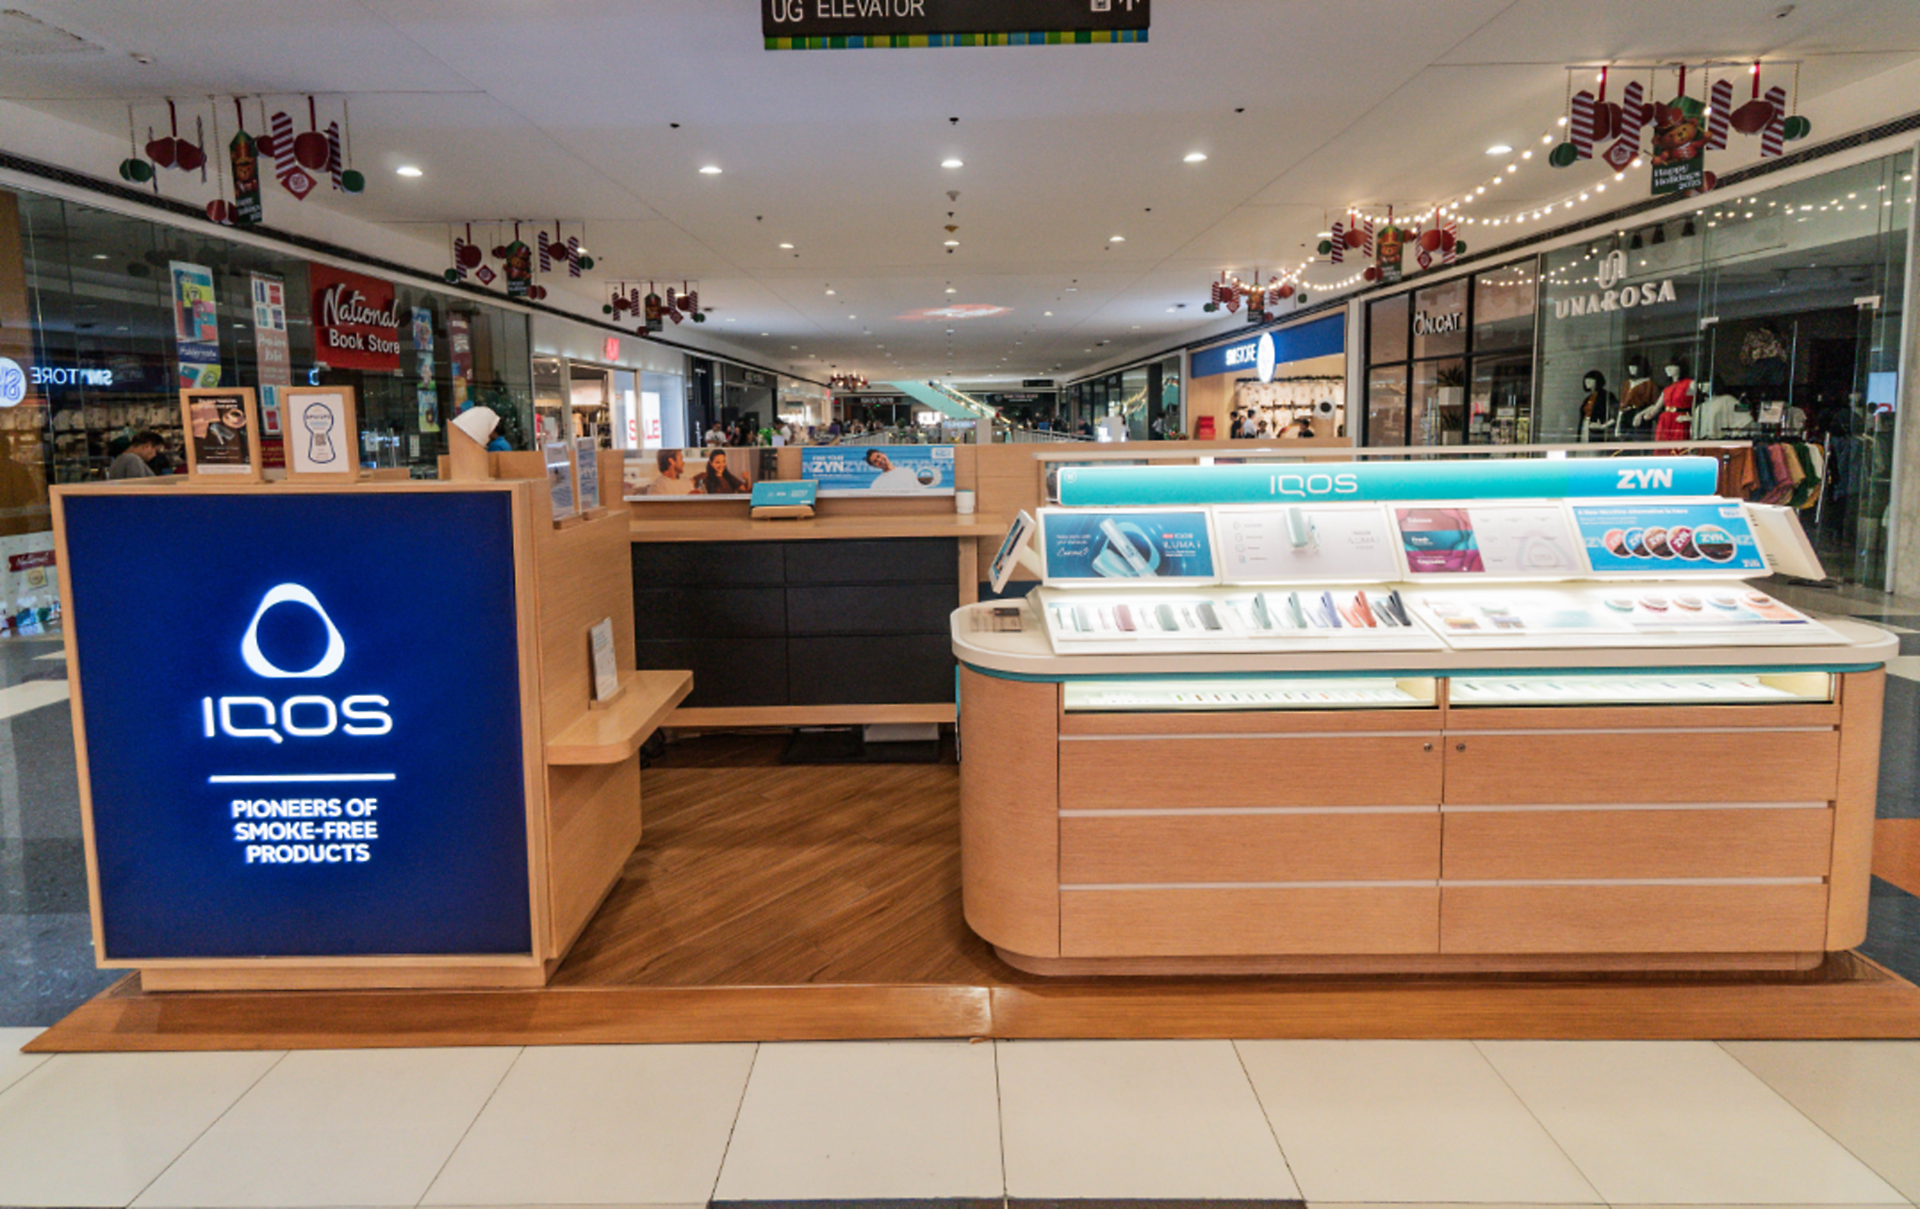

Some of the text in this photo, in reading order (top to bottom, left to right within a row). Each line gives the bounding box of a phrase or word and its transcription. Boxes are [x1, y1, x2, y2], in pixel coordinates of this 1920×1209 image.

[772, 0, 925, 23] UG ELEVATOR
[323, 283, 400, 328] National
[1555, 280, 1677, 319] UNAROSA
[329, 328, 400, 354] Book Store
[812, 461, 844, 473] ZYN
[1616, 468, 1673, 489] ZYN
[1270, 473, 1358, 497] IQOS
[202, 694, 393, 744] IQOS
[231, 798, 378, 818] PIONEERS OF
[234, 821, 378, 841] SMOKE-FREE
[245, 843, 371, 863] PRODUCTS
